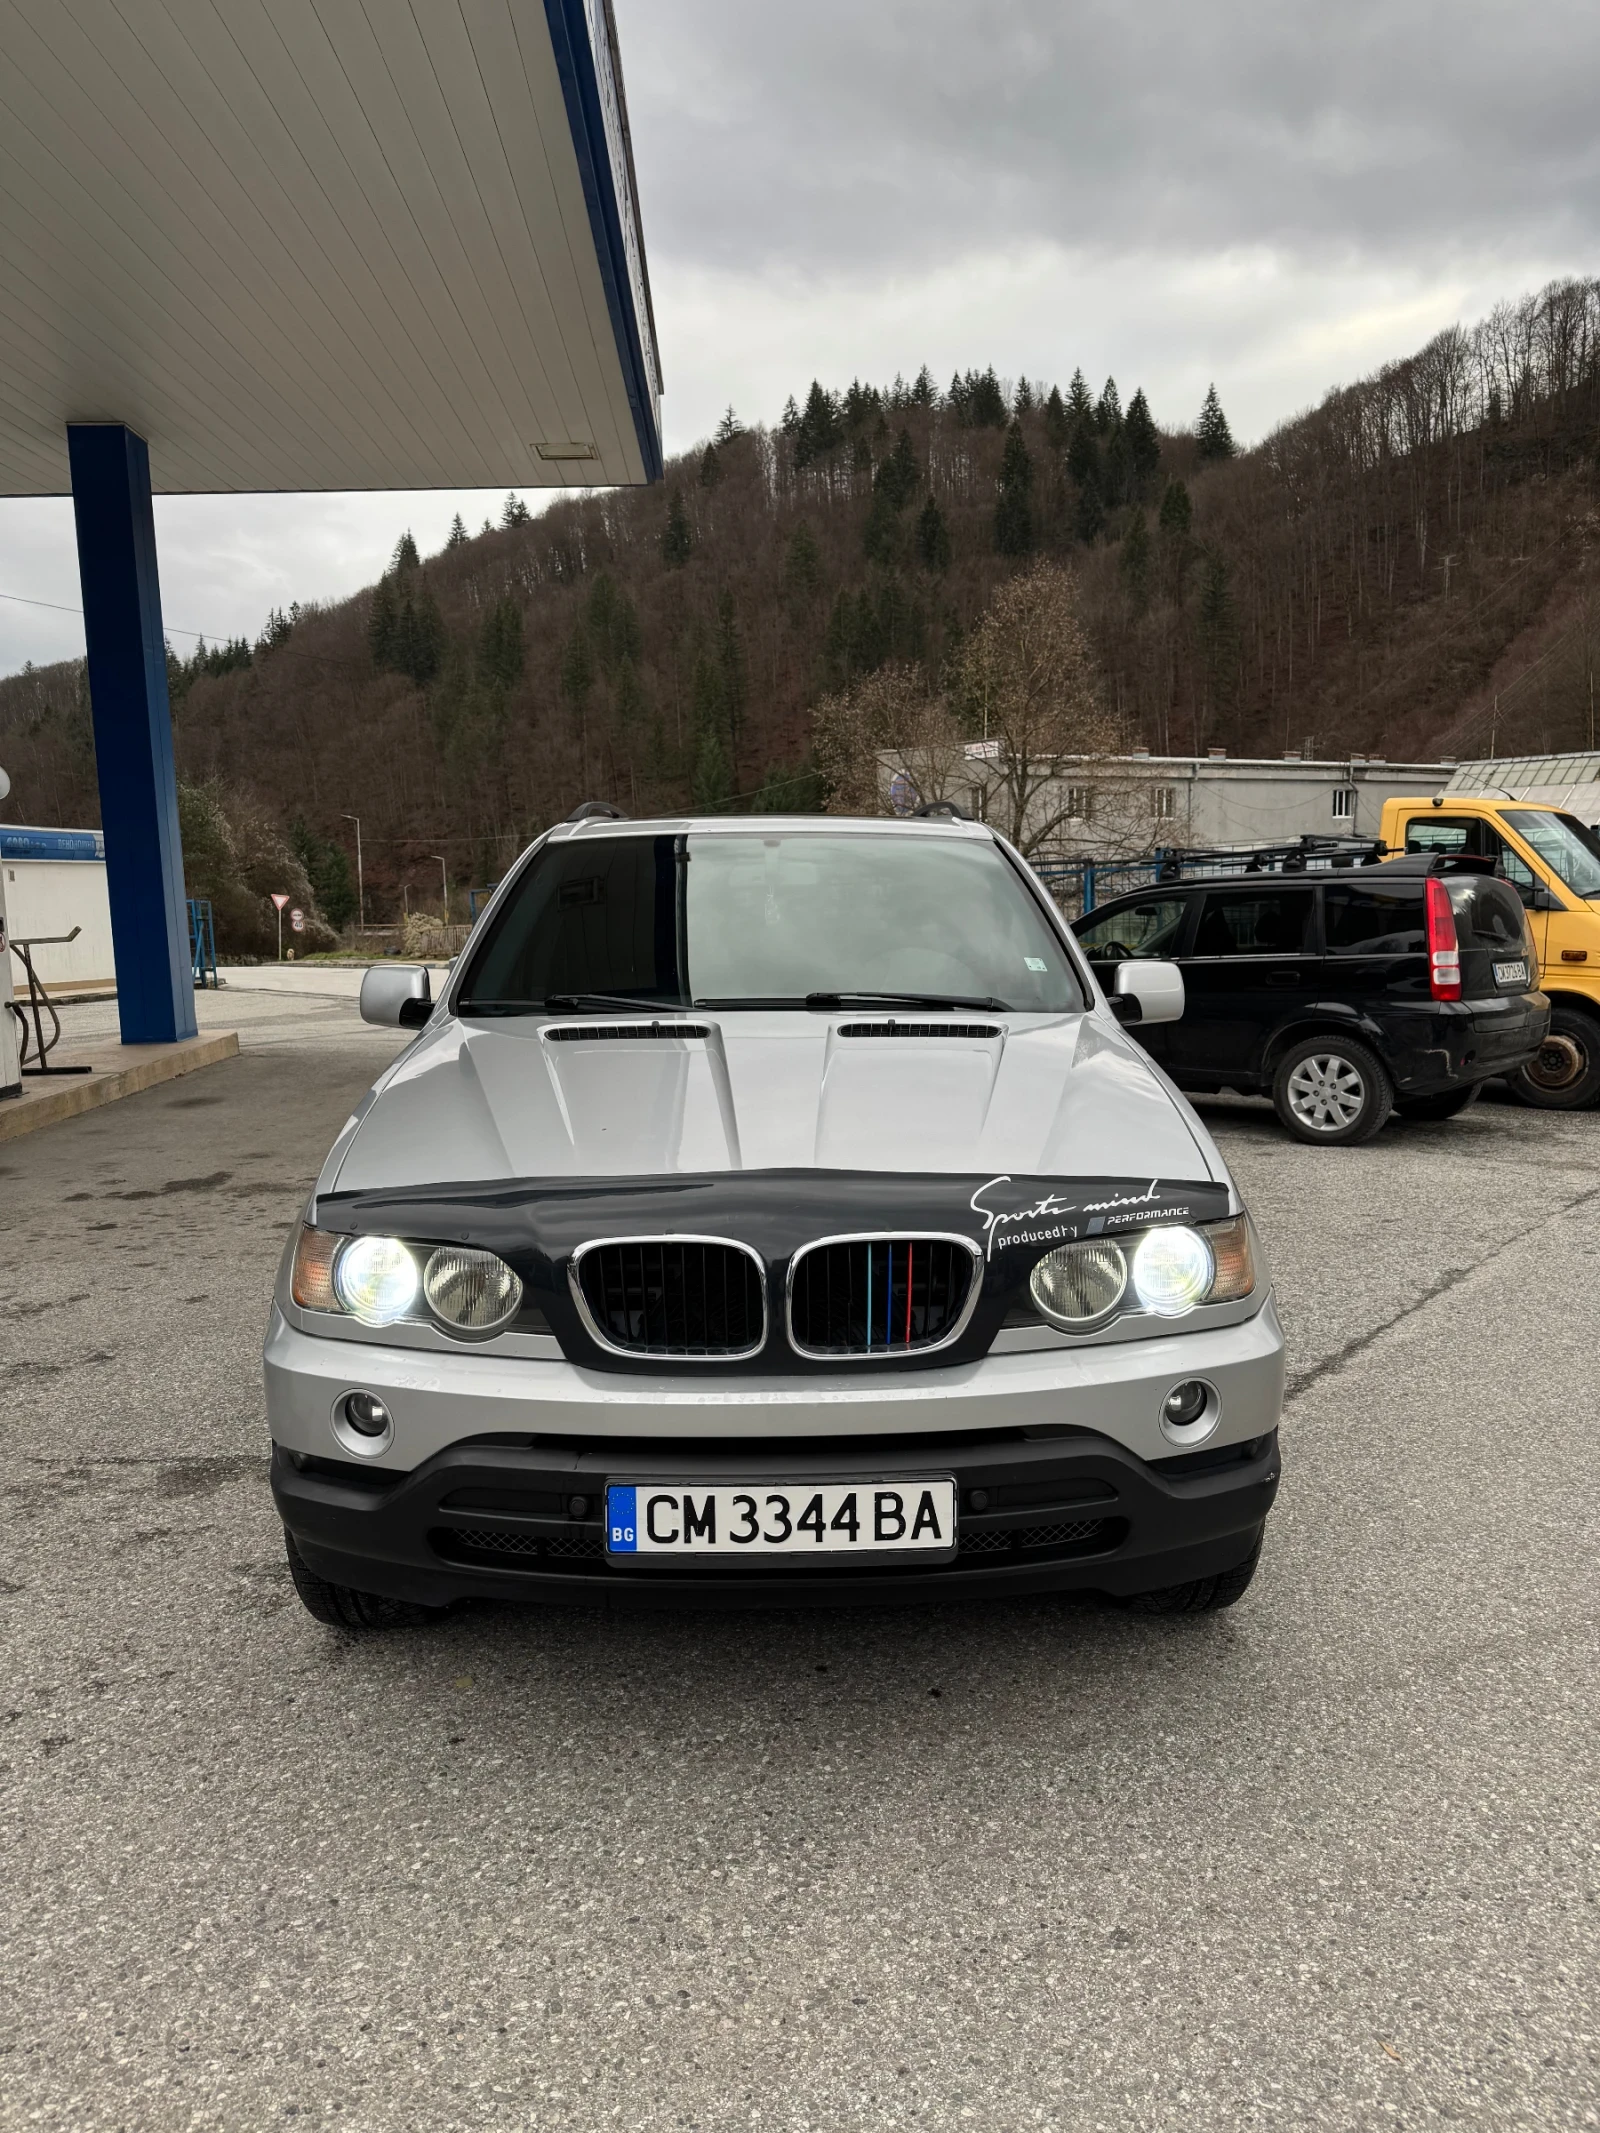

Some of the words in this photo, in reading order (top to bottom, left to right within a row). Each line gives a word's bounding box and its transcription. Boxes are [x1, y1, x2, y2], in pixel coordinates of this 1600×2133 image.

[1082, 1179, 1160, 1213] mind
[1106, 1206, 1189, 1226] PERFORMANCE
[646, 1494, 717, 1544] CM
[729, 1492, 861, 1543] 3344
[873, 1490, 943, 1542] BA
[612, 1526, 634, 1543] BG
